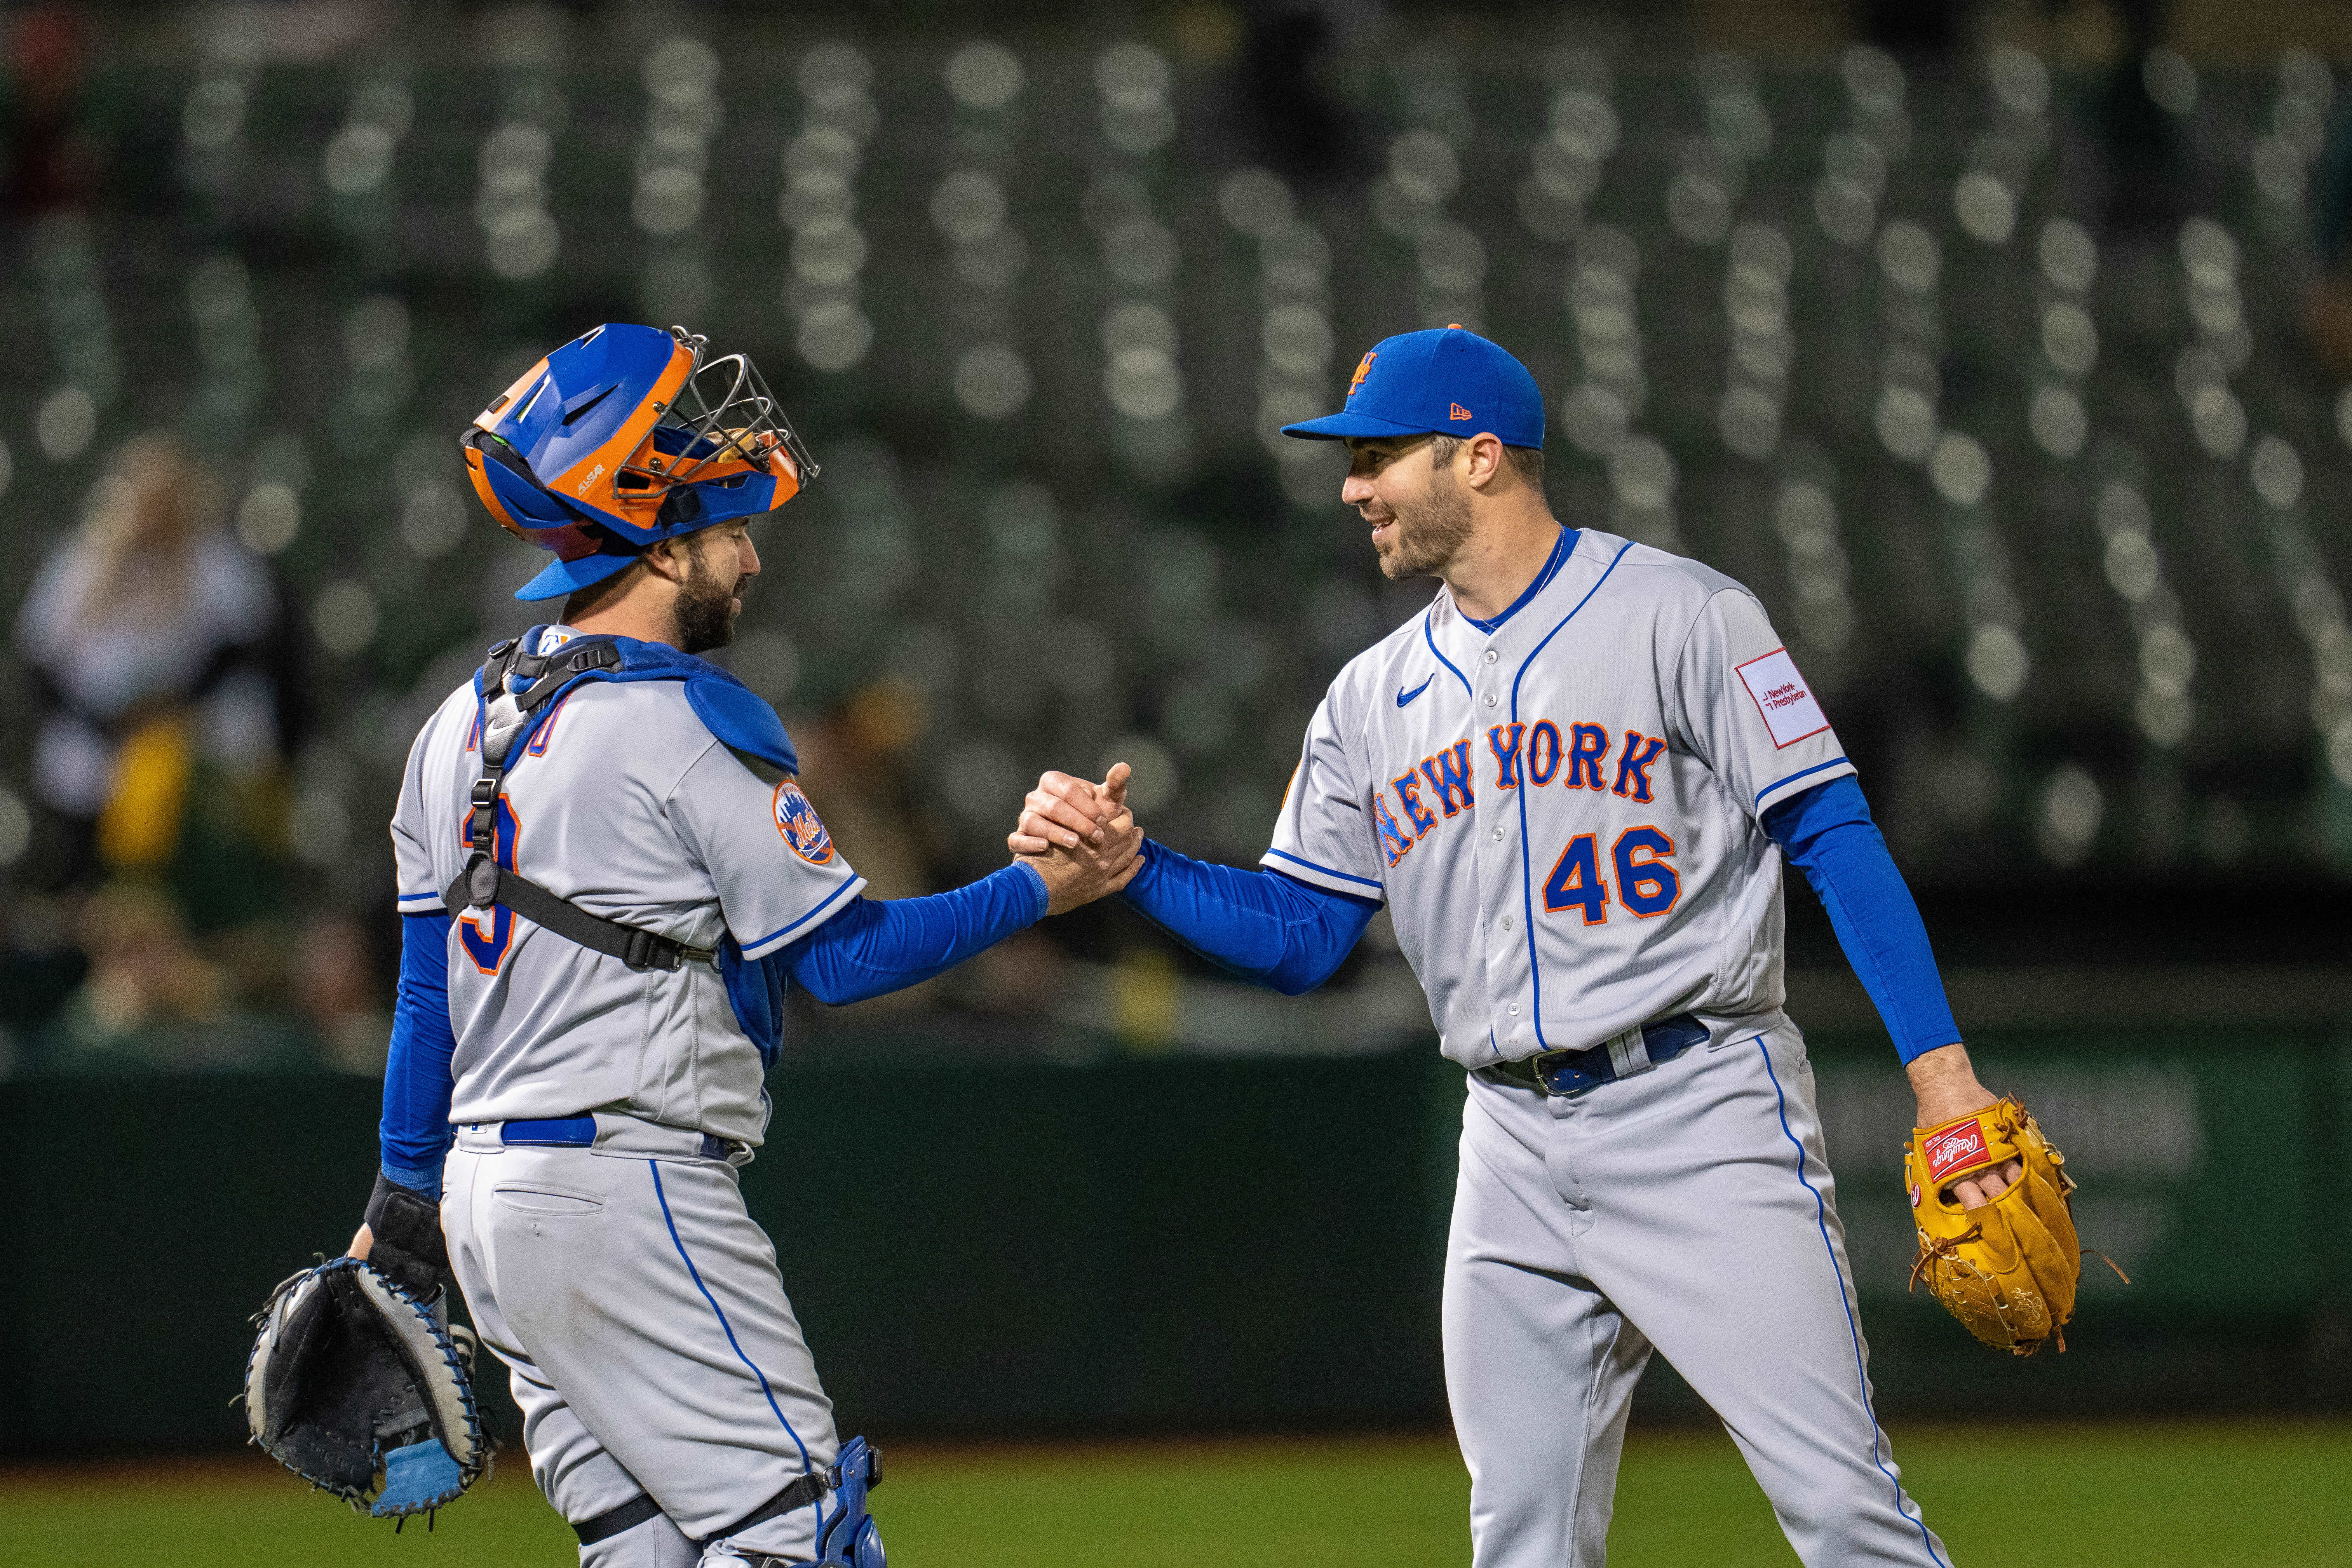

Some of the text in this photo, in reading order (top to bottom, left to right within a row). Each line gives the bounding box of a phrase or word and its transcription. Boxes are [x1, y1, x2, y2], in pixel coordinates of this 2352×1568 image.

[1772, 690, 1807, 709] Presbyterian
[1374, 719, 1667, 868] NEW YORK
[792, 808, 821, 849] Mets
[1542, 824, 1682, 927] 46
[1933, 1134, 1978, 1168] Rawlings
